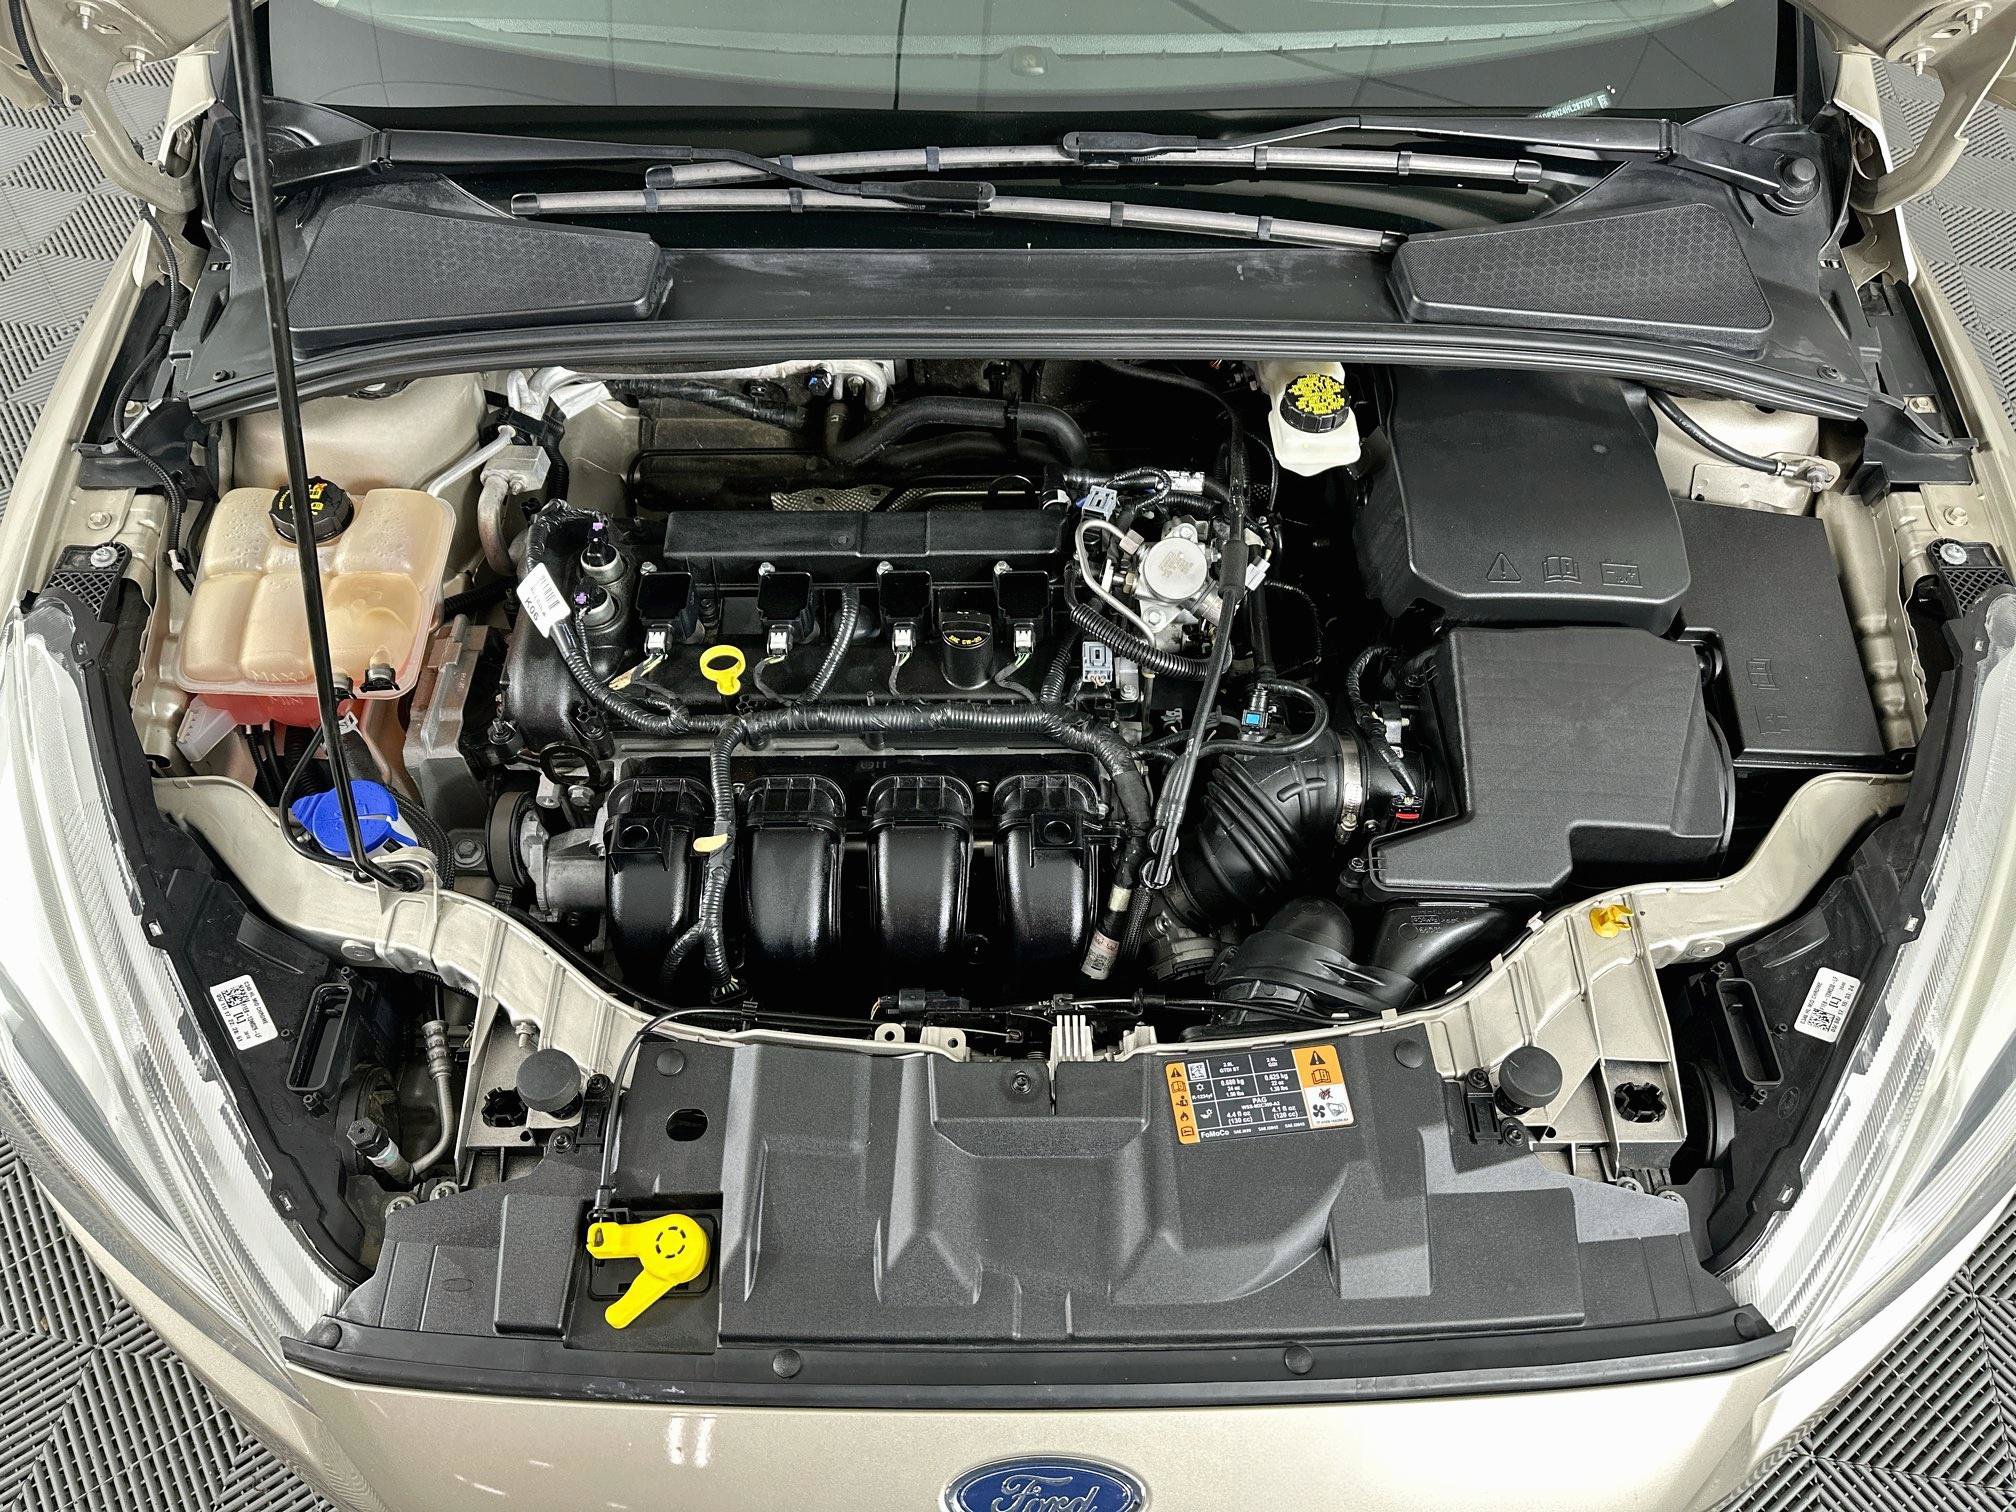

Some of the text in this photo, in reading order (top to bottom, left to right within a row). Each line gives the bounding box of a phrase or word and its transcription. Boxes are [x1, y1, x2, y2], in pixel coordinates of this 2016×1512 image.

[1533, 97, 1593, 119] ADP3N24HL287707
[1201, 1130, 1229, 1138] FoMoCo
[991, 1475, 1100, 1512] Ford
